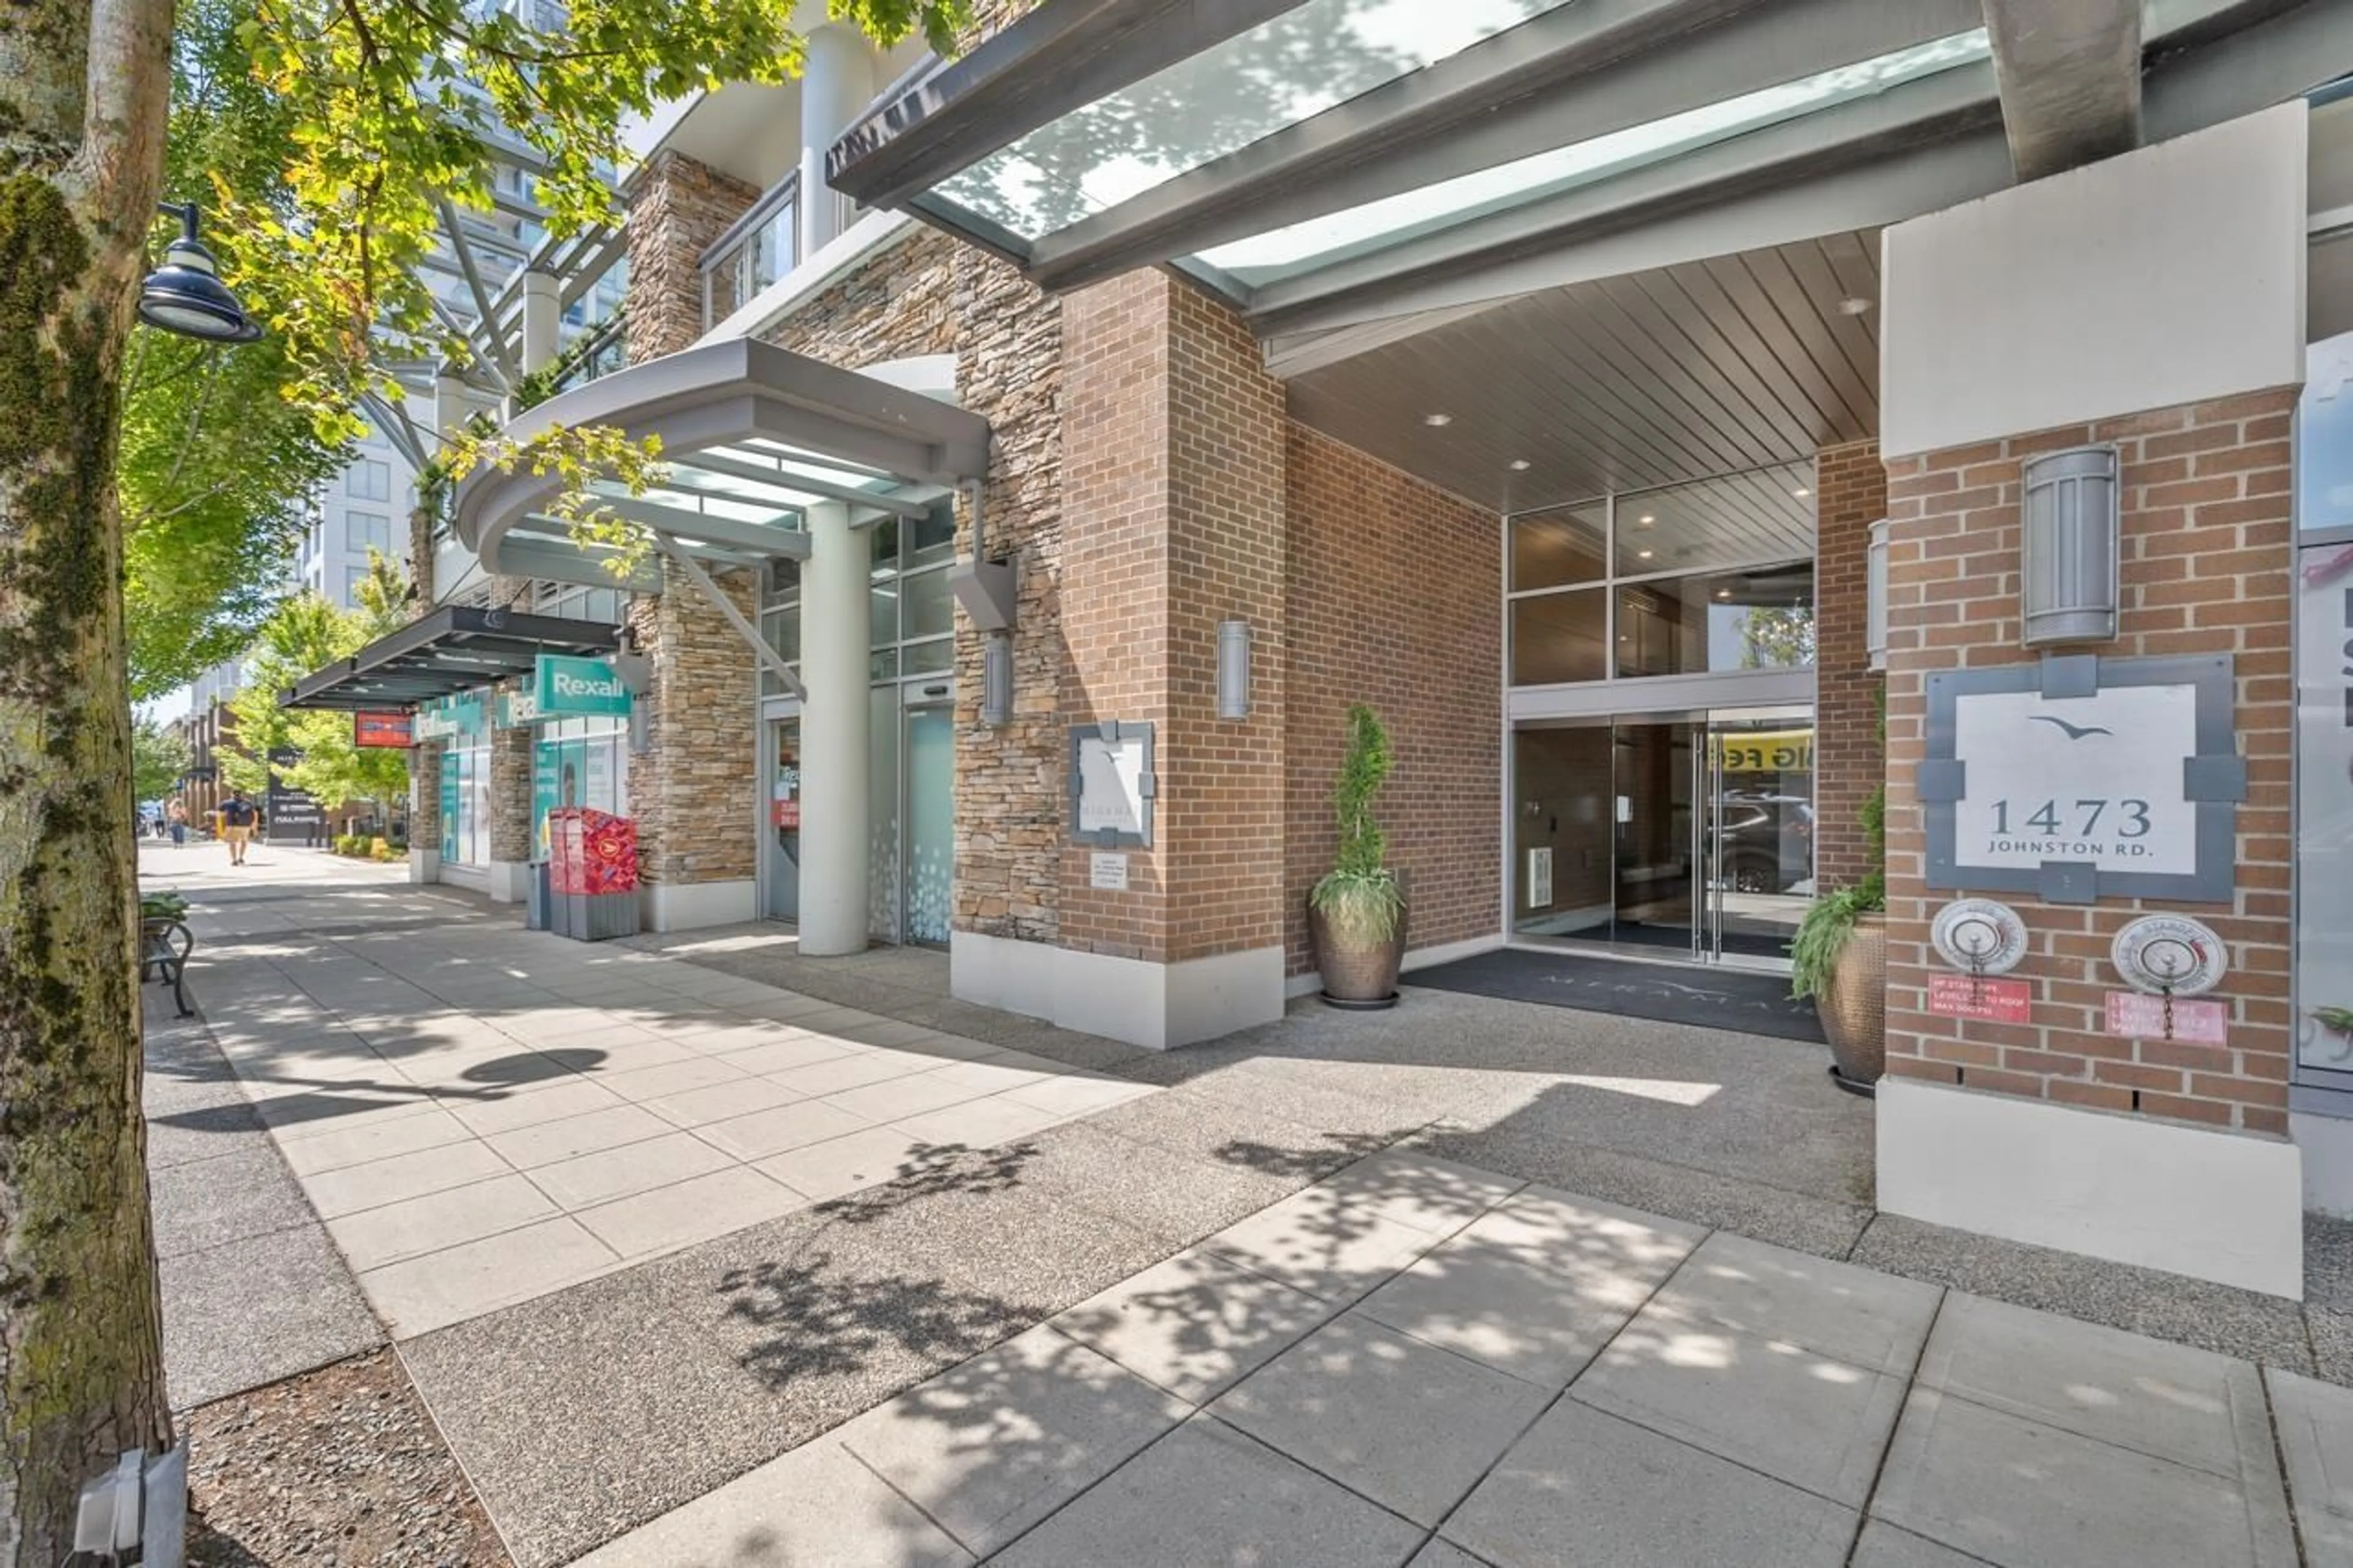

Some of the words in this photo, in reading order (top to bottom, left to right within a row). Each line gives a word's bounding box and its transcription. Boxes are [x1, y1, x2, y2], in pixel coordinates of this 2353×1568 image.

[553, 673, 623, 697] Rexall
[1990, 799, 2151, 837] 1473
[1988, 840, 2103, 854] JOHNSTON
[2115, 844, 2153, 857] RD.
